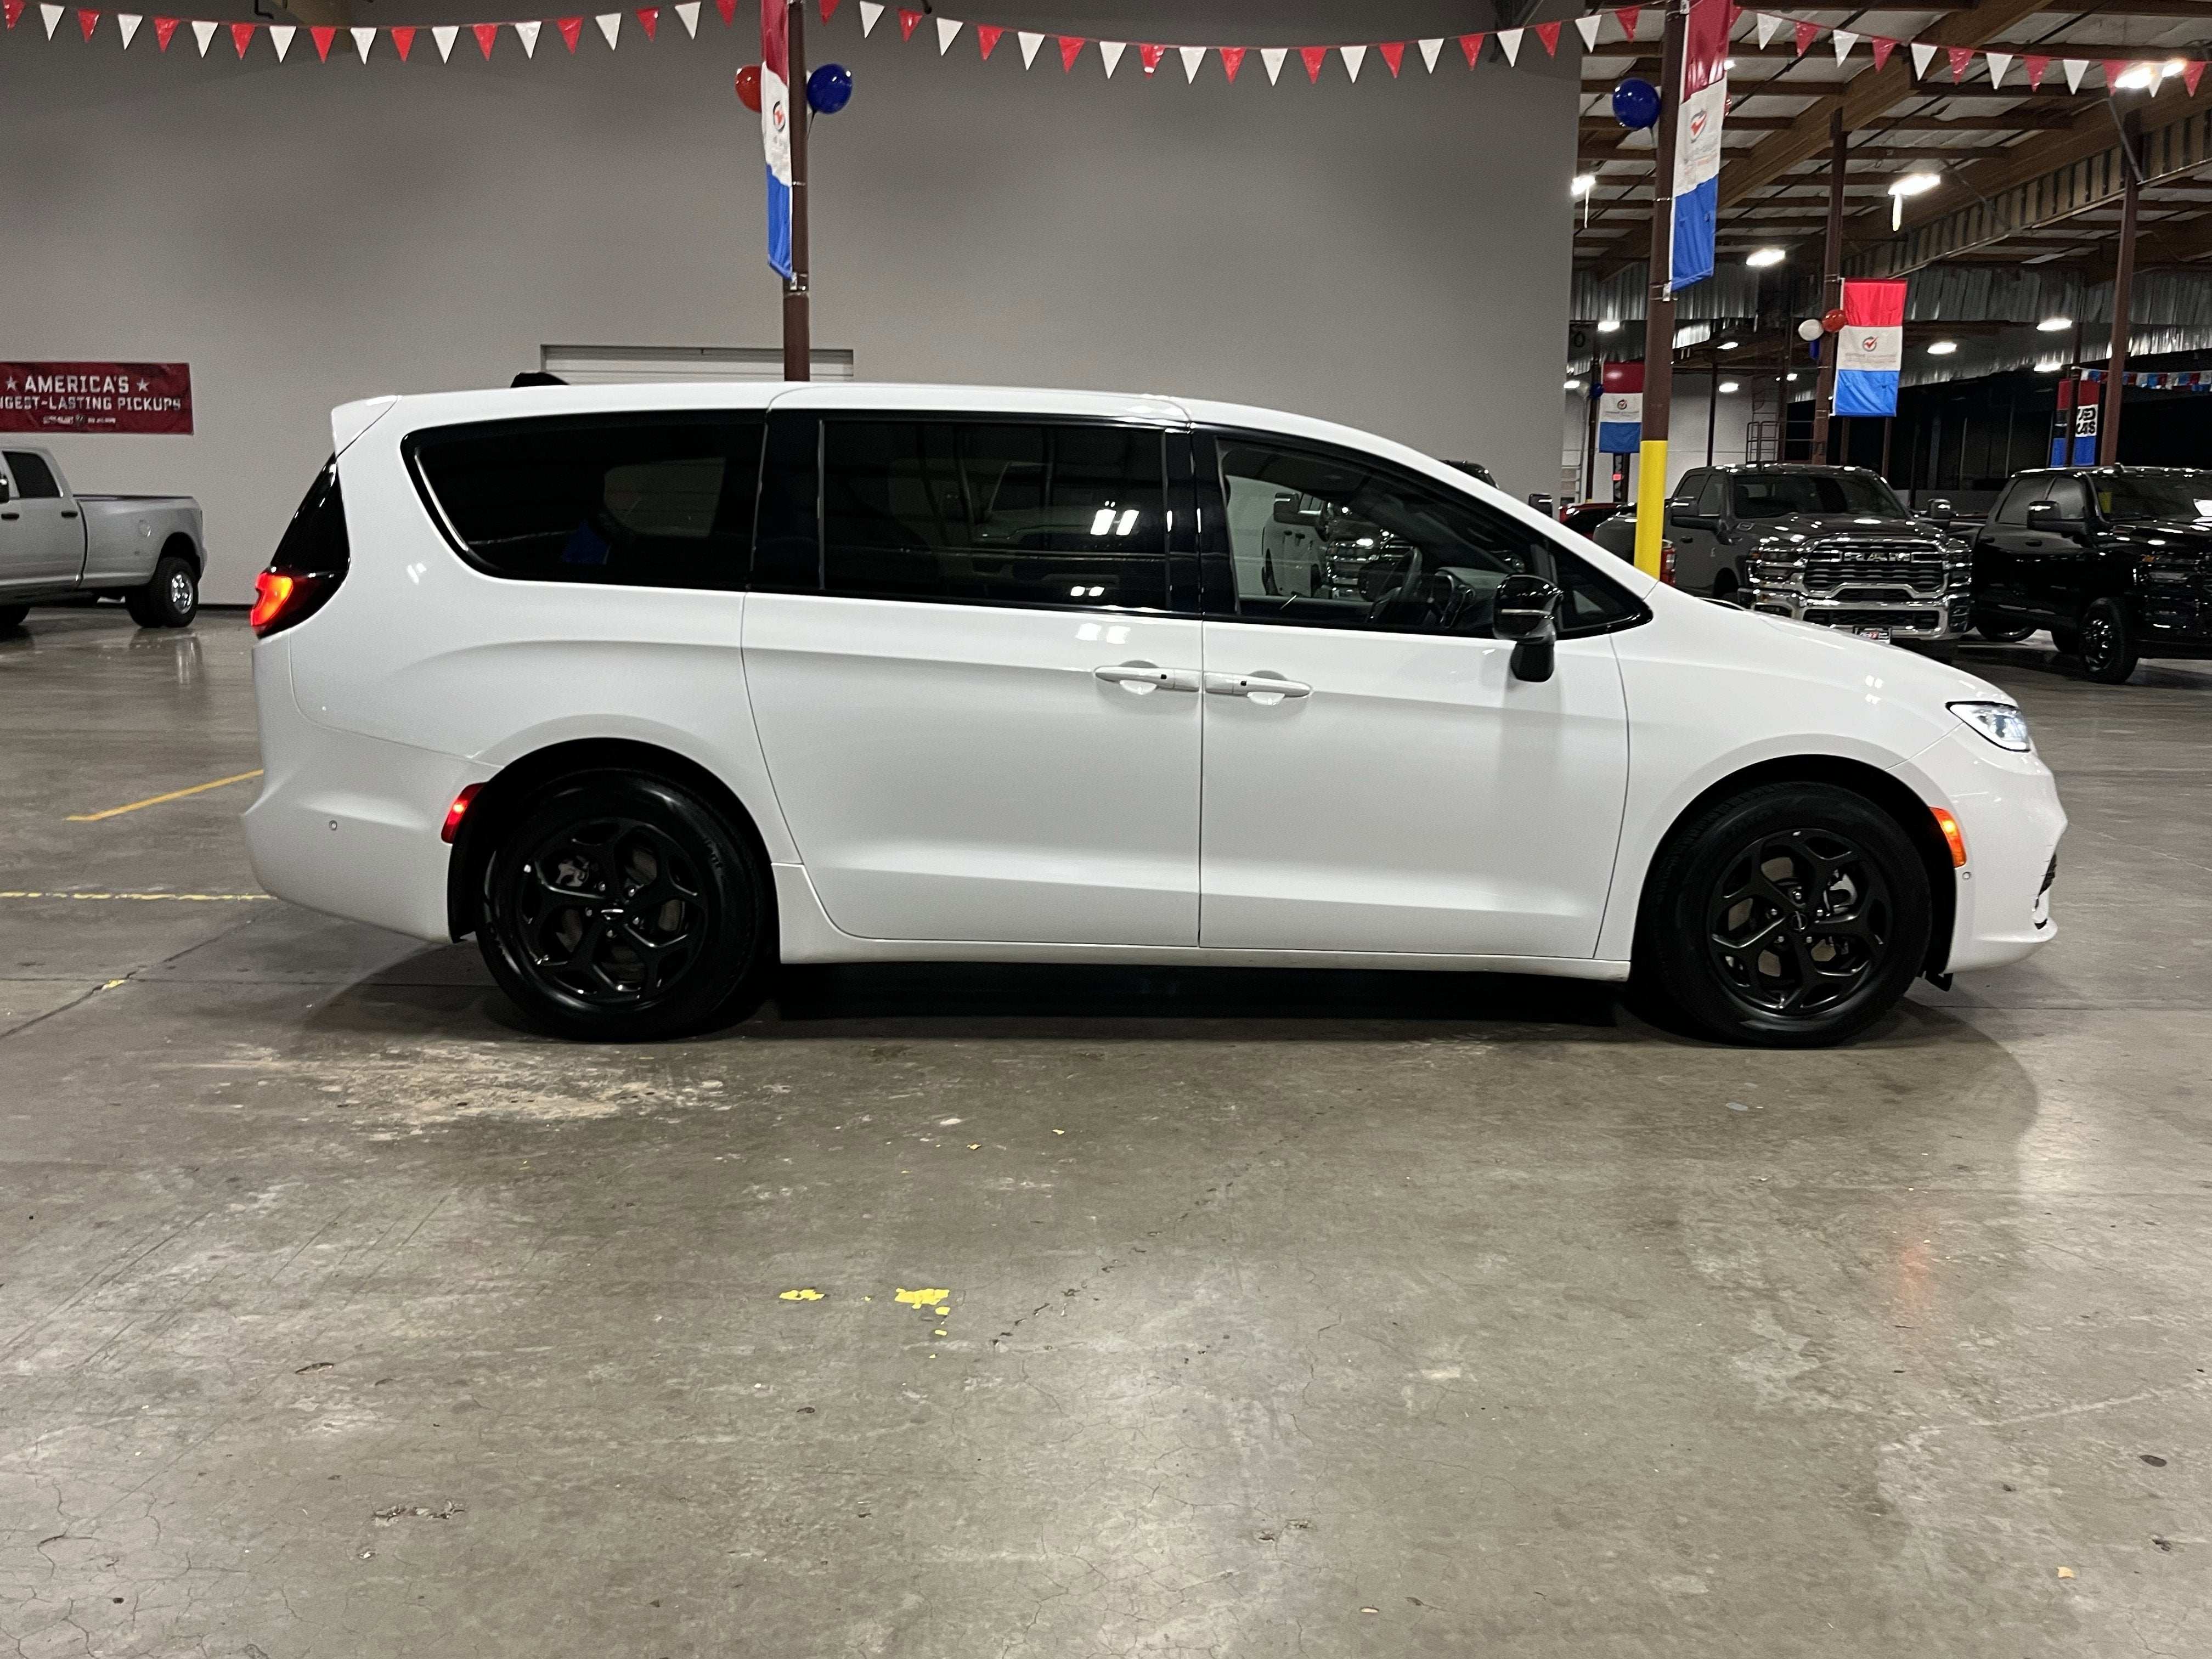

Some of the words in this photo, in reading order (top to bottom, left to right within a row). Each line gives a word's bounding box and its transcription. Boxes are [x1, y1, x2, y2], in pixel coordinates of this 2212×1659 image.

[25, 375, 129, 393] AMERICA'S
[117, 397, 181, 411] PICKUPS
[1843, 552, 1910, 562] RAM
